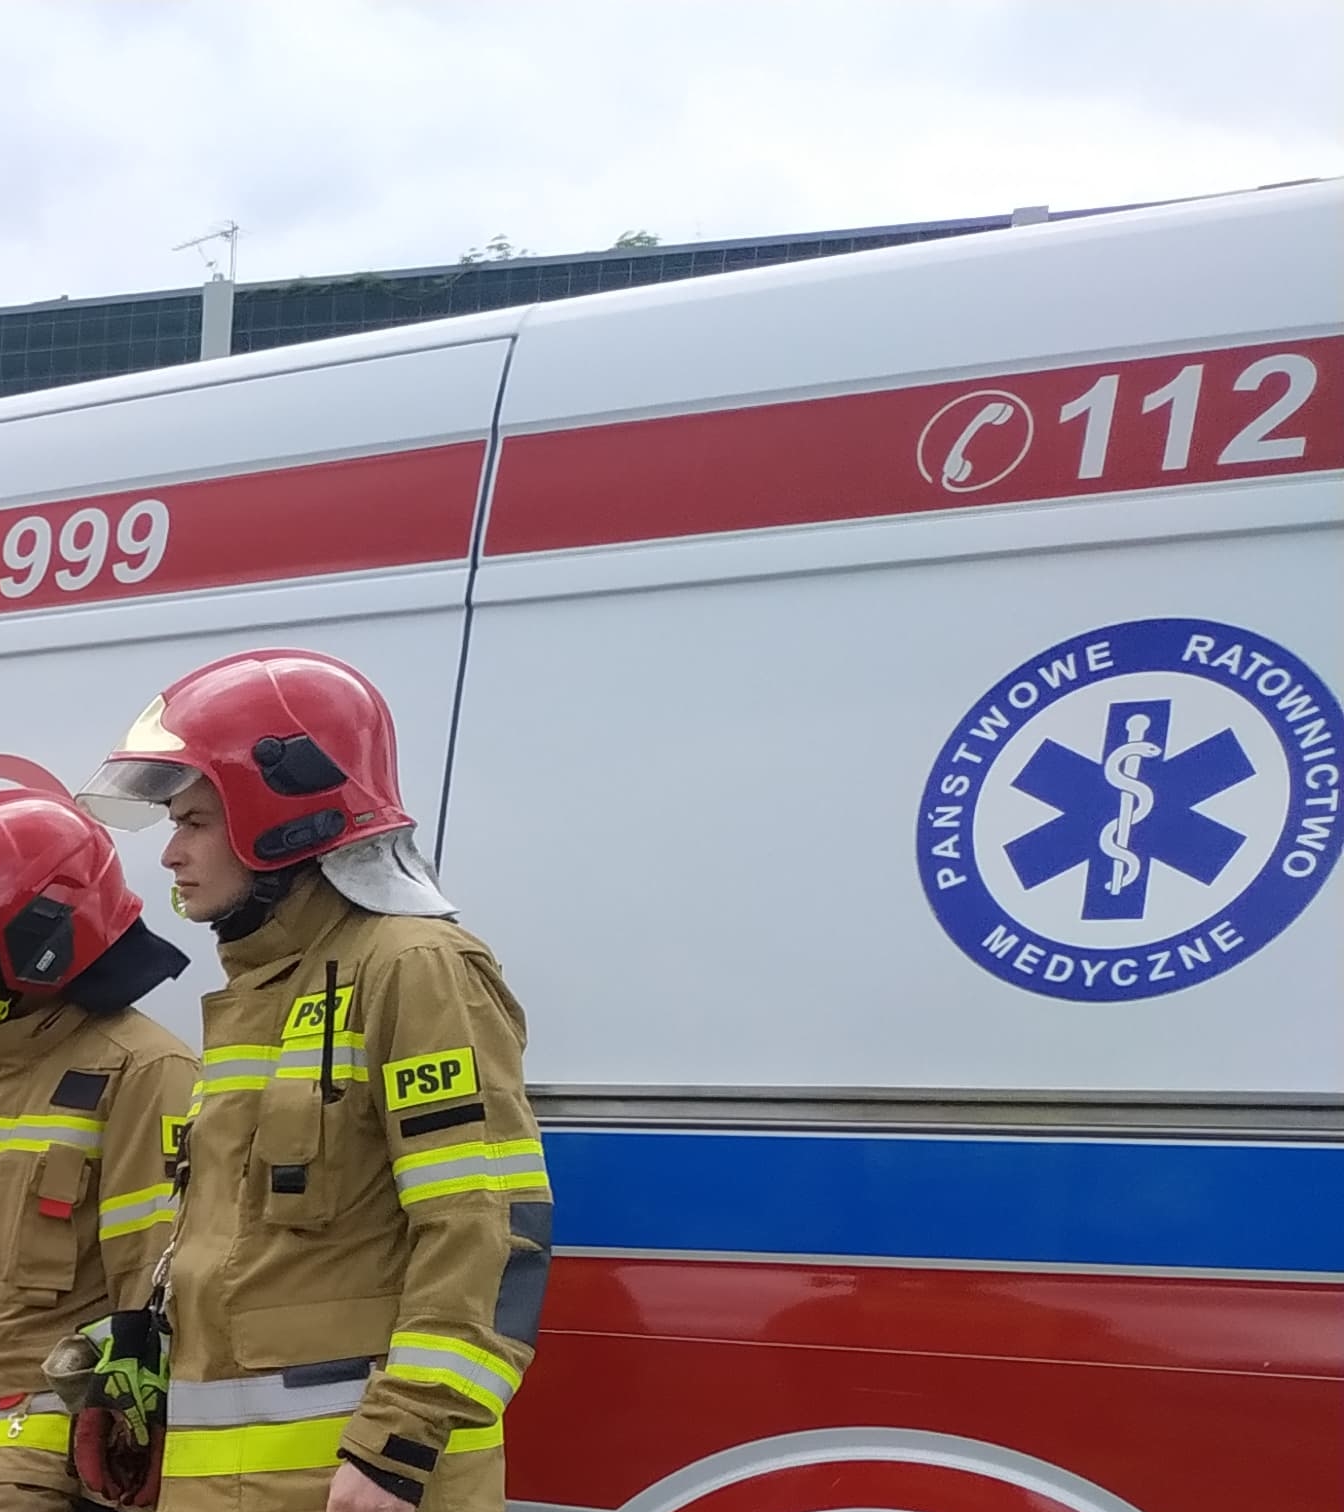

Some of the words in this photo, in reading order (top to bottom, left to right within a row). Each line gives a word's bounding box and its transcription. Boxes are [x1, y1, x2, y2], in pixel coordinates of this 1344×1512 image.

[1059, 353, 1318, 480] 112
[927, 641, 1115, 890] PAŃSTWOWE
[1181, 634, 1340, 879] RATOWNICTWO
[982, 920, 1245, 988] MEDYCZNE
[395, 1059, 461, 1100] PSP
